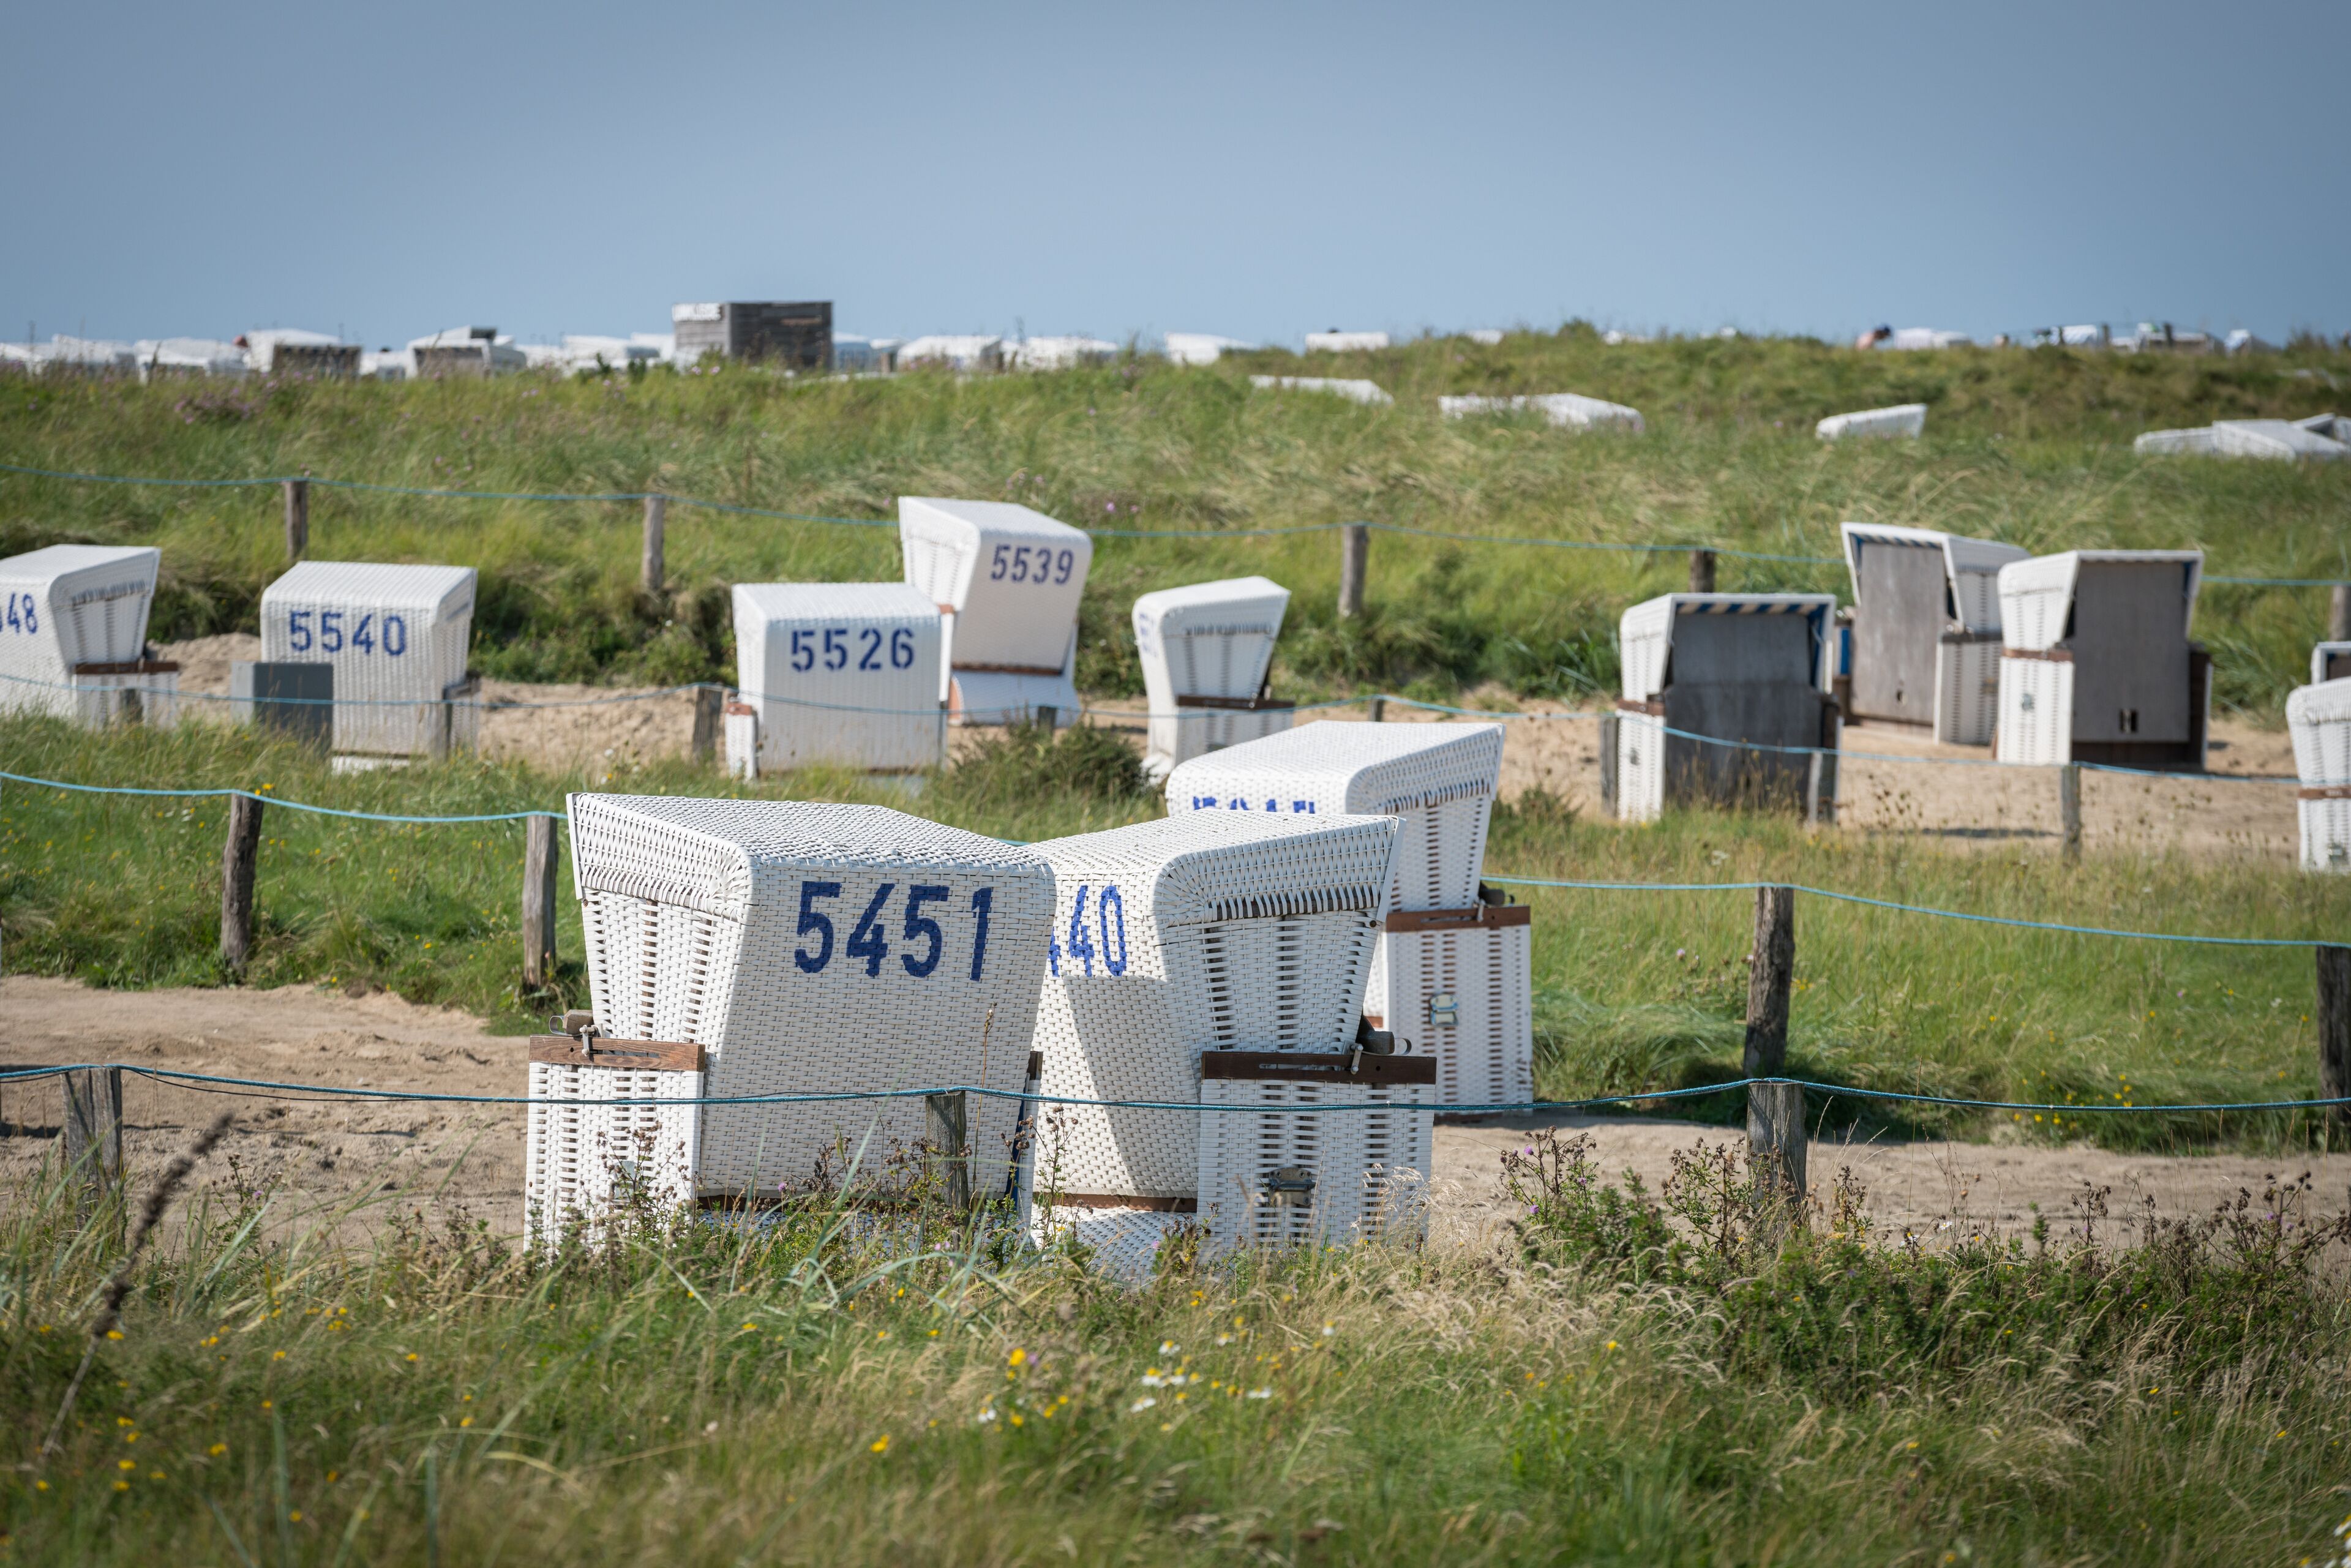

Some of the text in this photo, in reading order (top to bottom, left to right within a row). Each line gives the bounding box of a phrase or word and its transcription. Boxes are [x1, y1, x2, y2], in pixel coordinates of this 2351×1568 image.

[991, 544, 1074, 585] 5539
[0, 593, 38, 634] 48
[290, 610, 405, 656] 5540
[792, 626, 914, 671] 5526
[795, 881, 993, 981] 5451
